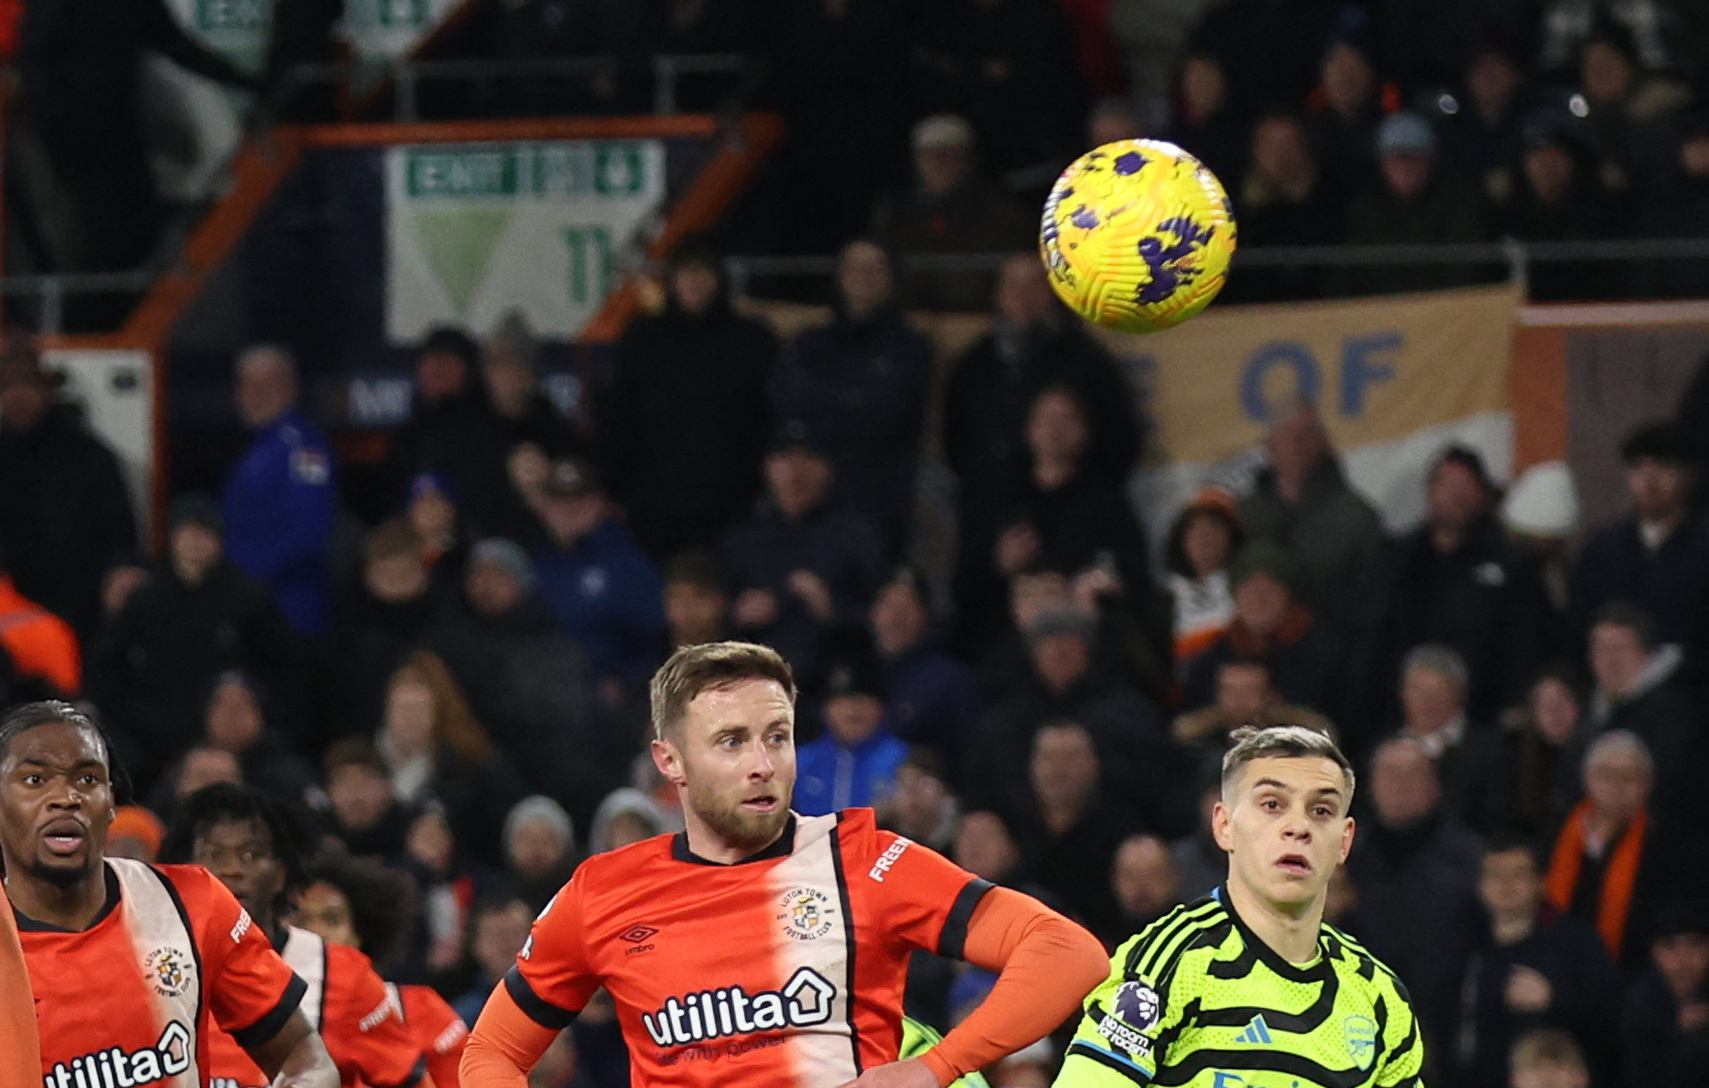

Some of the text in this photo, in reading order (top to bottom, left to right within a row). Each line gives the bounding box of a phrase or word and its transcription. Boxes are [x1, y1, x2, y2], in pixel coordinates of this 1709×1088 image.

[1238, 325, 1405, 425] OF
[780, 887, 828, 908] LUTON TOWN
[782, 920, 833, 941] FOOTBALL CLUB
[642, 985, 786, 1048] utilita
[1098, 1014, 1150, 1049] No room
